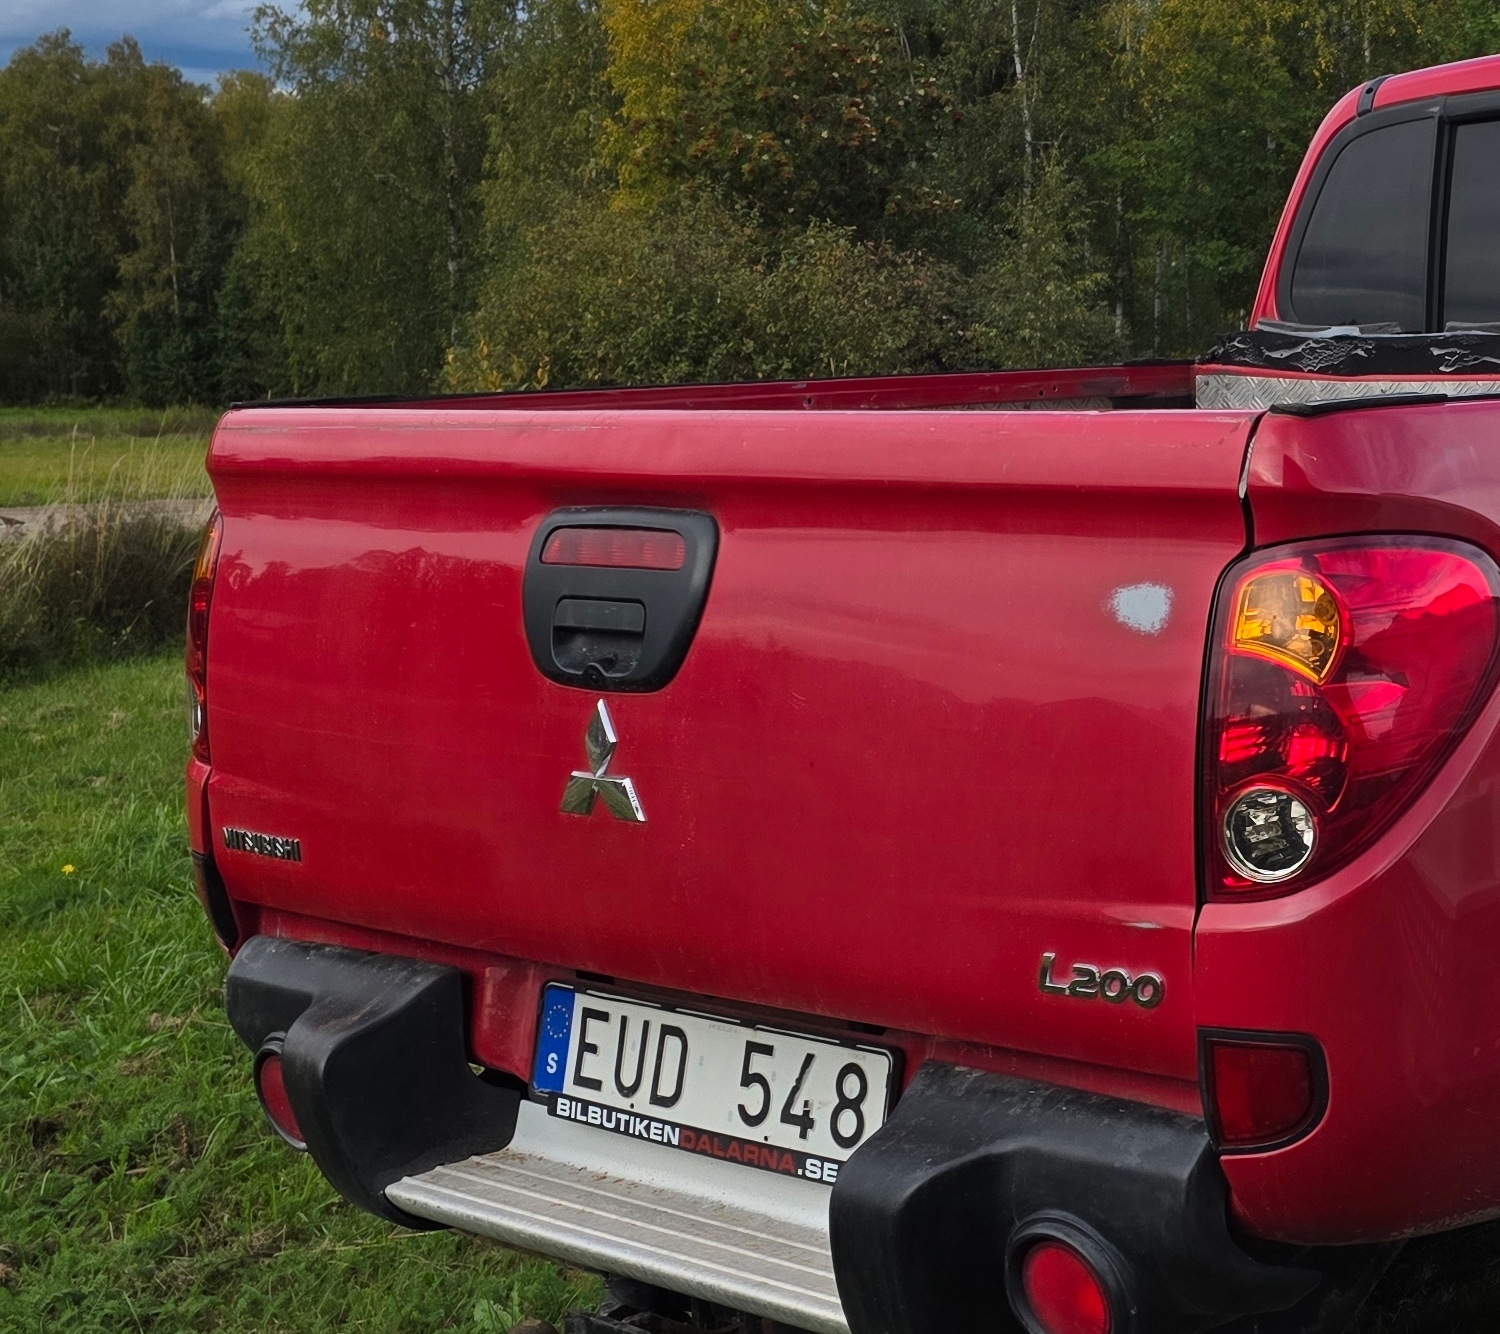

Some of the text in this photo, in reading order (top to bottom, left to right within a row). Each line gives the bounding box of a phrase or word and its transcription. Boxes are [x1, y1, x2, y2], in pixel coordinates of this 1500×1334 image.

[1038, 952, 1166, 1009] L200
[546, 1052, 558, 1074] S
[572, 1006, 868, 1150] EUD 548
